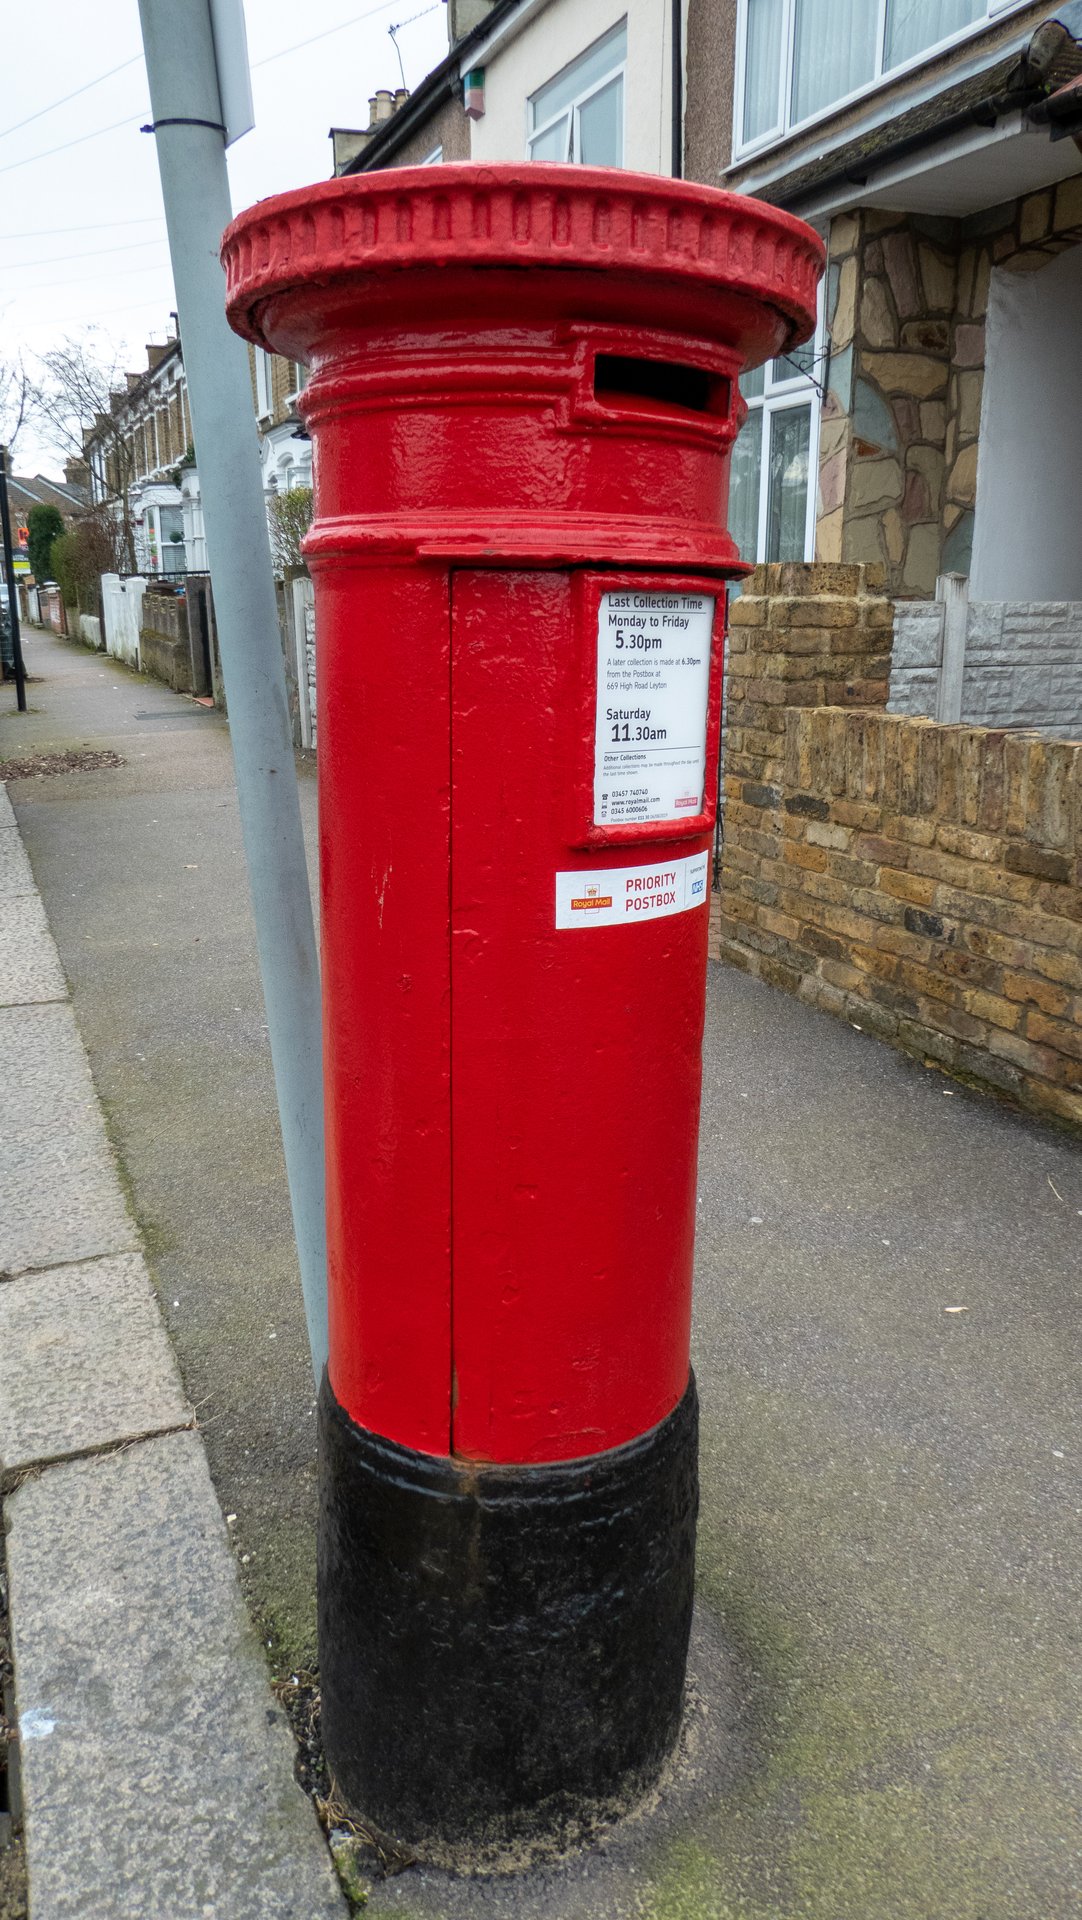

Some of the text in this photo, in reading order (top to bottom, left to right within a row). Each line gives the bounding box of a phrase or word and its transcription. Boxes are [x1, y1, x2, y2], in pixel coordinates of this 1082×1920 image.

[608, 595, 703, 610] Last Collection Time
[608, 614, 690, 630] Monday to Friday
[615, 630, 662, 651] 5.30pm
[607, 657, 701, 667] A later collection is made at 6.30pm
[606, 670, 621, 678] from
[622, 670, 631, 678] the
[633, 670, 654, 678] Postbox
[606, 681, 667, 692] 669 High Road Leyton
[606, 708, 651, 721] Saturday
[611, 723, 667, 742] 11.30am
[612, 789, 648, 798] 03457 740740
[612, 797, 661, 806] www.royalmail.com
[611, 806, 648, 815] 0345 6000606
[626, 872, 676, 892] PRIORITY
[573, 898, 611, 909] Royal Mail
[625, 891, 676, 911] POSTBOX
